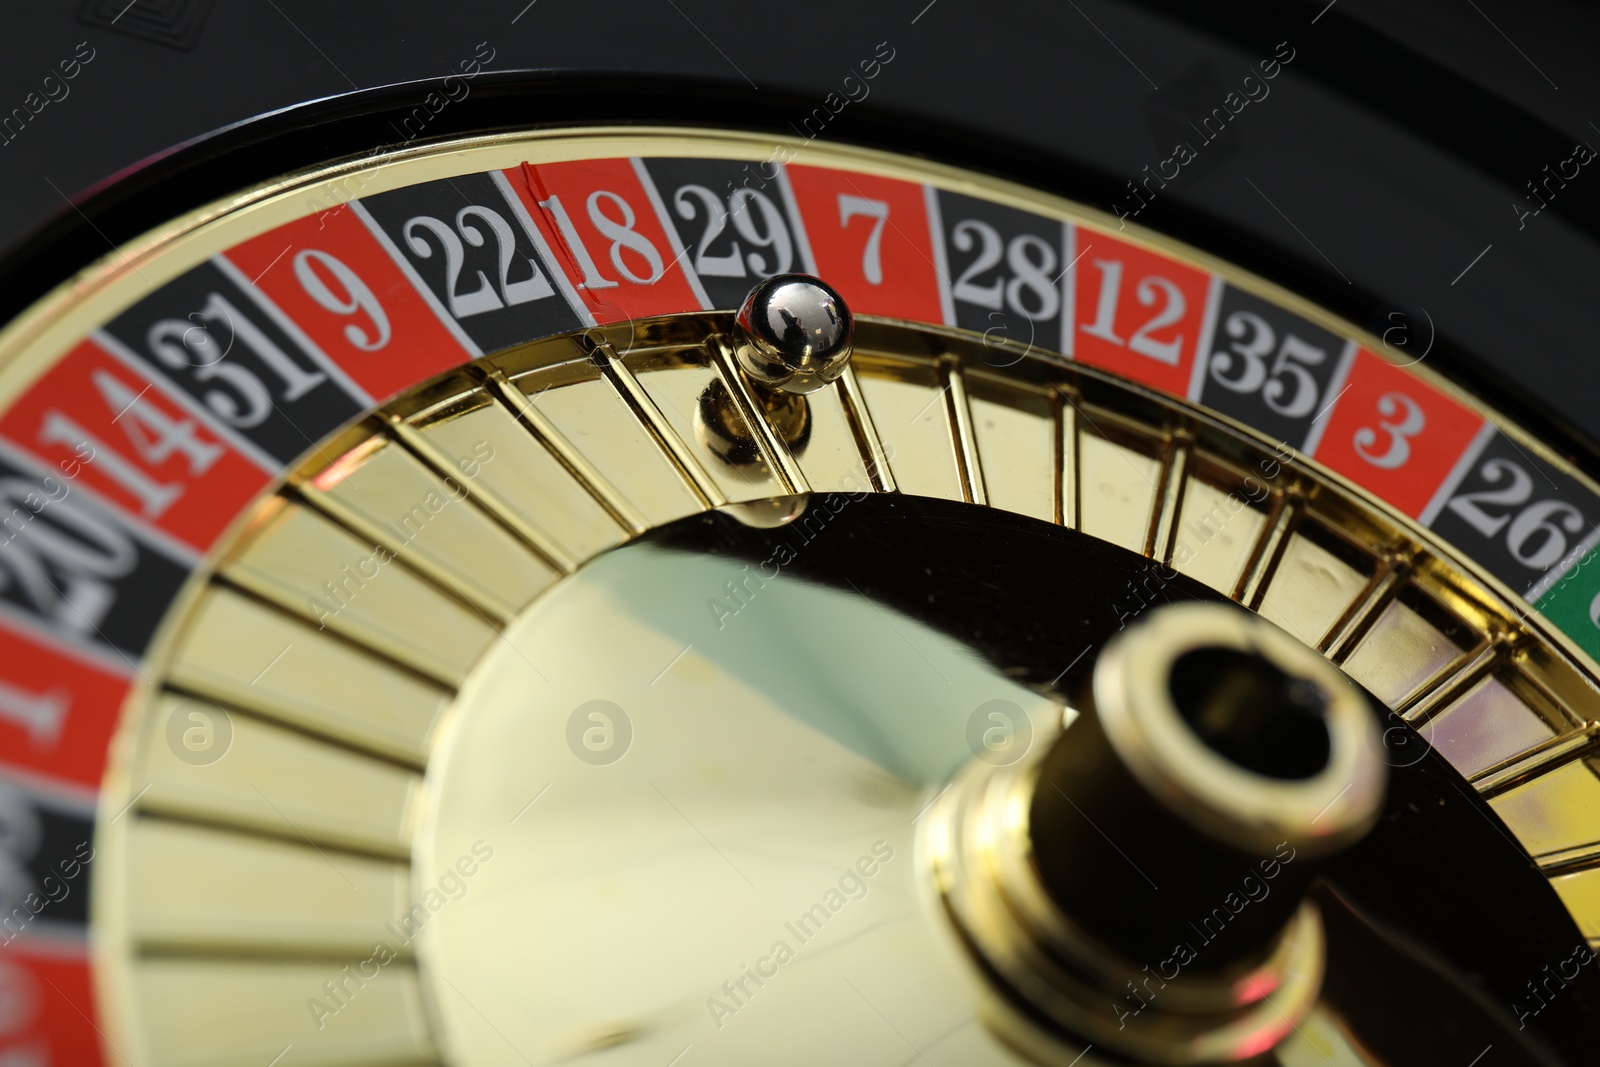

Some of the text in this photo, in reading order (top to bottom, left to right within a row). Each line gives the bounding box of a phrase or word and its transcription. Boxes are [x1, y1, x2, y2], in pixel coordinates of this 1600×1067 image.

[403, 205, 556, 319] 22
[539, 189, 665, 291] 18
[673, 184, 793, 279] 29
[837, 193, 891, 285] 7
[952, 218, 1061, 323] 28
[292, 247, 393, 352] 9
[1080, 258, 1188, 366] 12
[148, 292, 328, 429] 31
[1208, 310, 1326, 420] 35
[38, 368, 230, 518] 14
[1353, 391, 1426, 471] 3
[1447, 457, 1584, 570] 26
